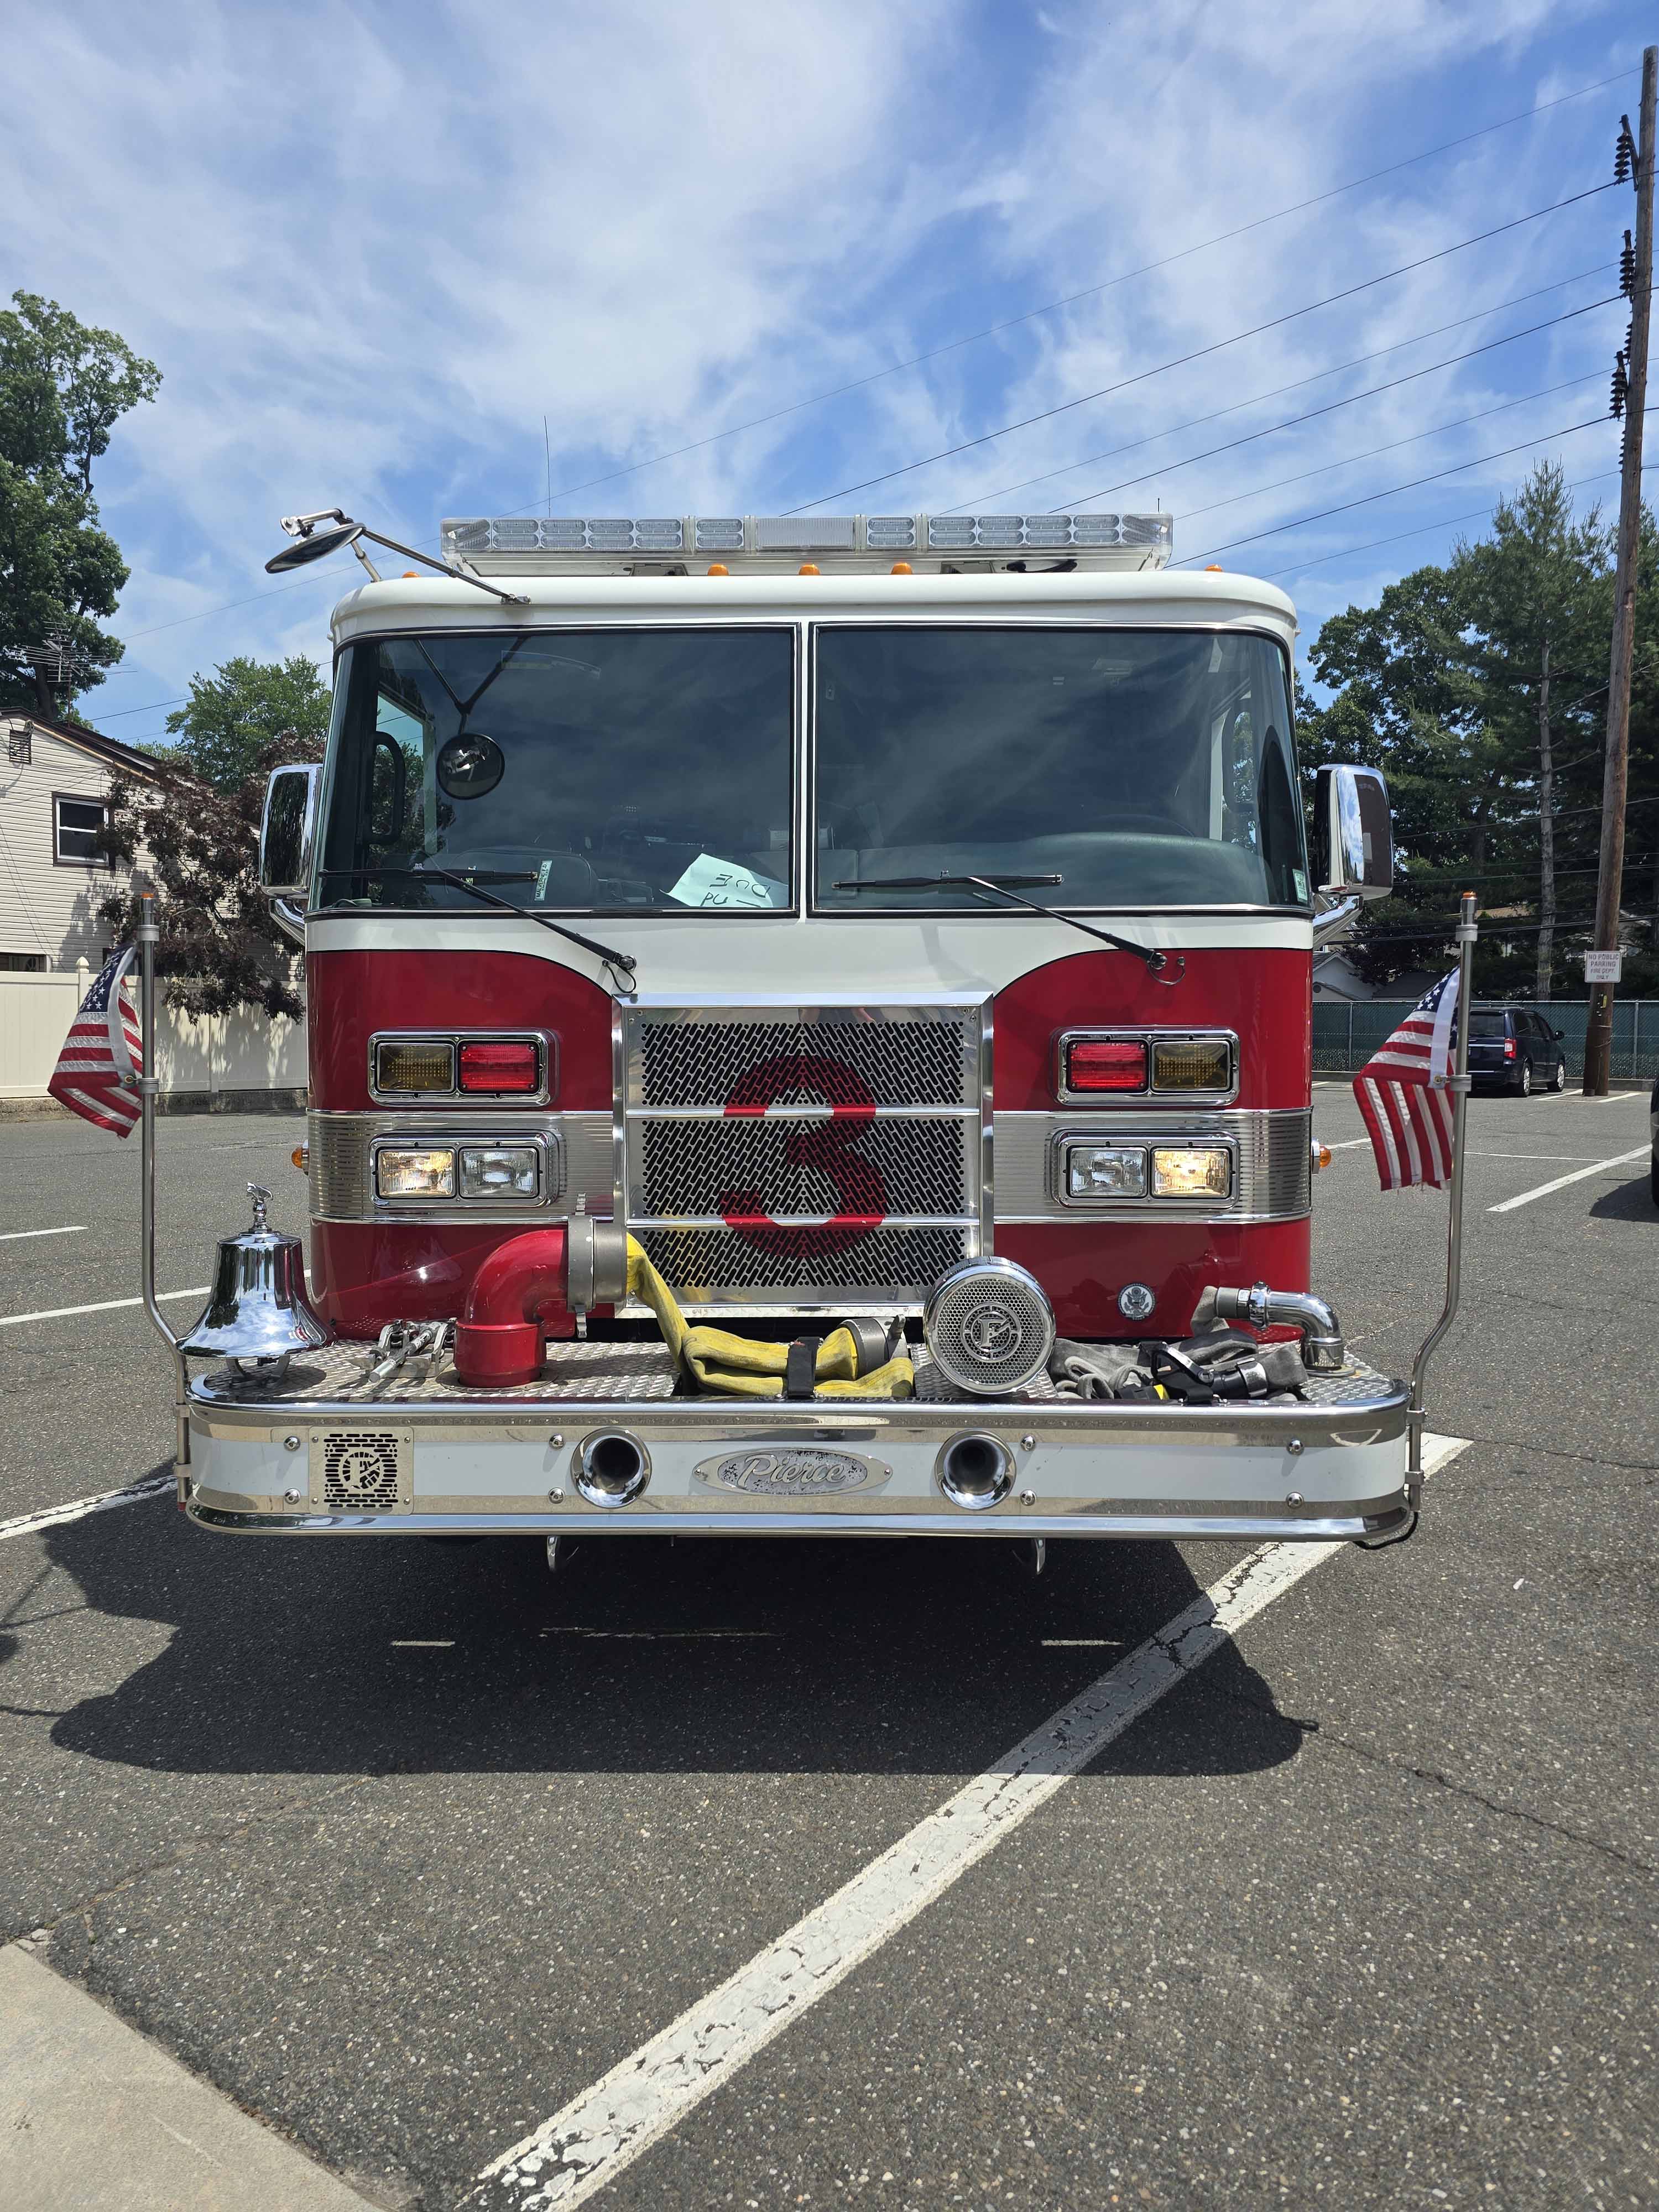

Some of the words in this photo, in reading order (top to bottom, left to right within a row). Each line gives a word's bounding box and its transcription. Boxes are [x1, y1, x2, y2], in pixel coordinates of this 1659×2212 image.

[536, 873, 545, 898] MALVERNE
[718, 1055, 888, 1258] 3
[737, 1453, 846, 1488] Pierce
